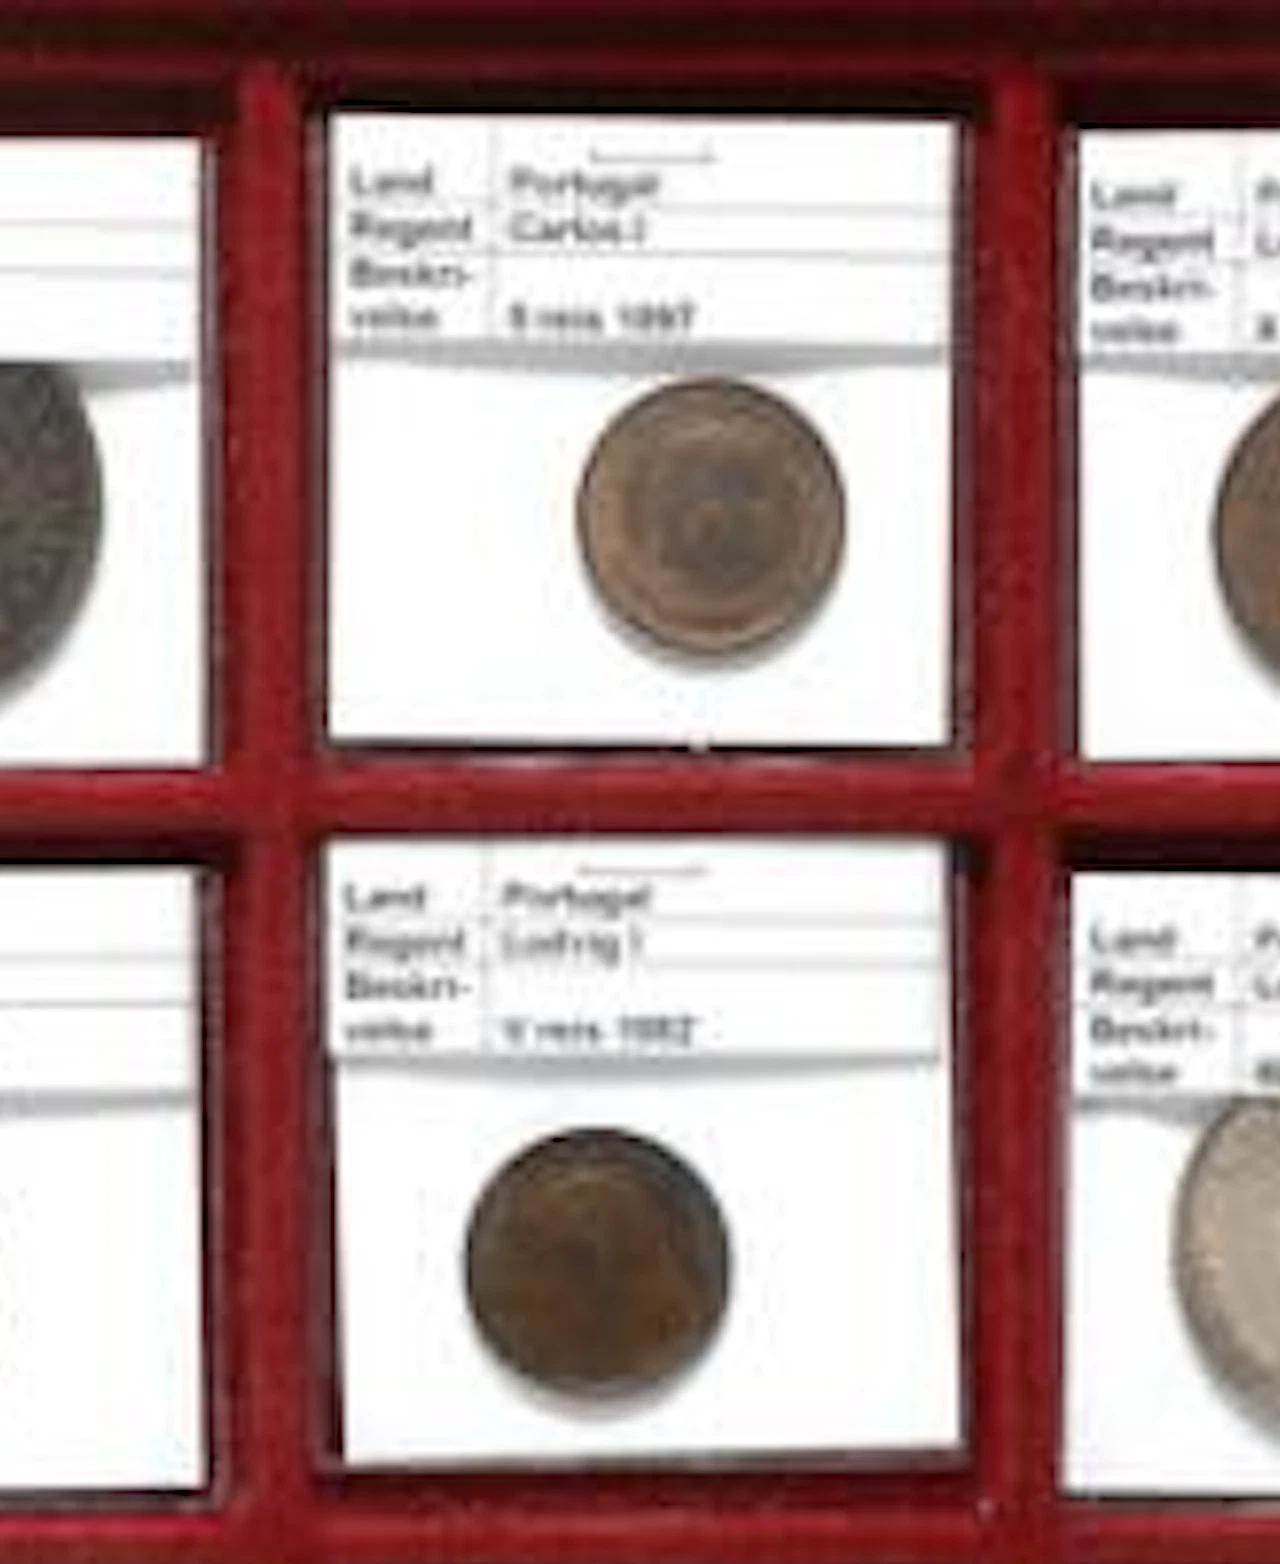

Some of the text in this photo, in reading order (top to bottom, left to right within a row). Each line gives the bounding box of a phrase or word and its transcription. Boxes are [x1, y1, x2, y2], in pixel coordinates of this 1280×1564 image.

[348, 166, 435, 198] Land
[509, 167, 660, 207] Portugal
[1089, 182, 1178, 212] Land
[348, 209, 474, 253] Regent
[509, 211, 625, 245] Carlos
[1089, 223, 1216, 266] Regent
[350, 304, 439, 330] velse
[1090, 318, 1179, 345] velse
[342, 883, 428, 915] Land
[501, 880, 652, 922] Portugal
[343, 924, 467, 966] Regent
[502, 928, 621, 967] Ludvig
[1088, 926, 1178, 957] Land
[1088, 966, 1216, 1009] Regent
[344, 1018, 433, 1044] velse
[1090, 1059, 1179, 1087] velse
